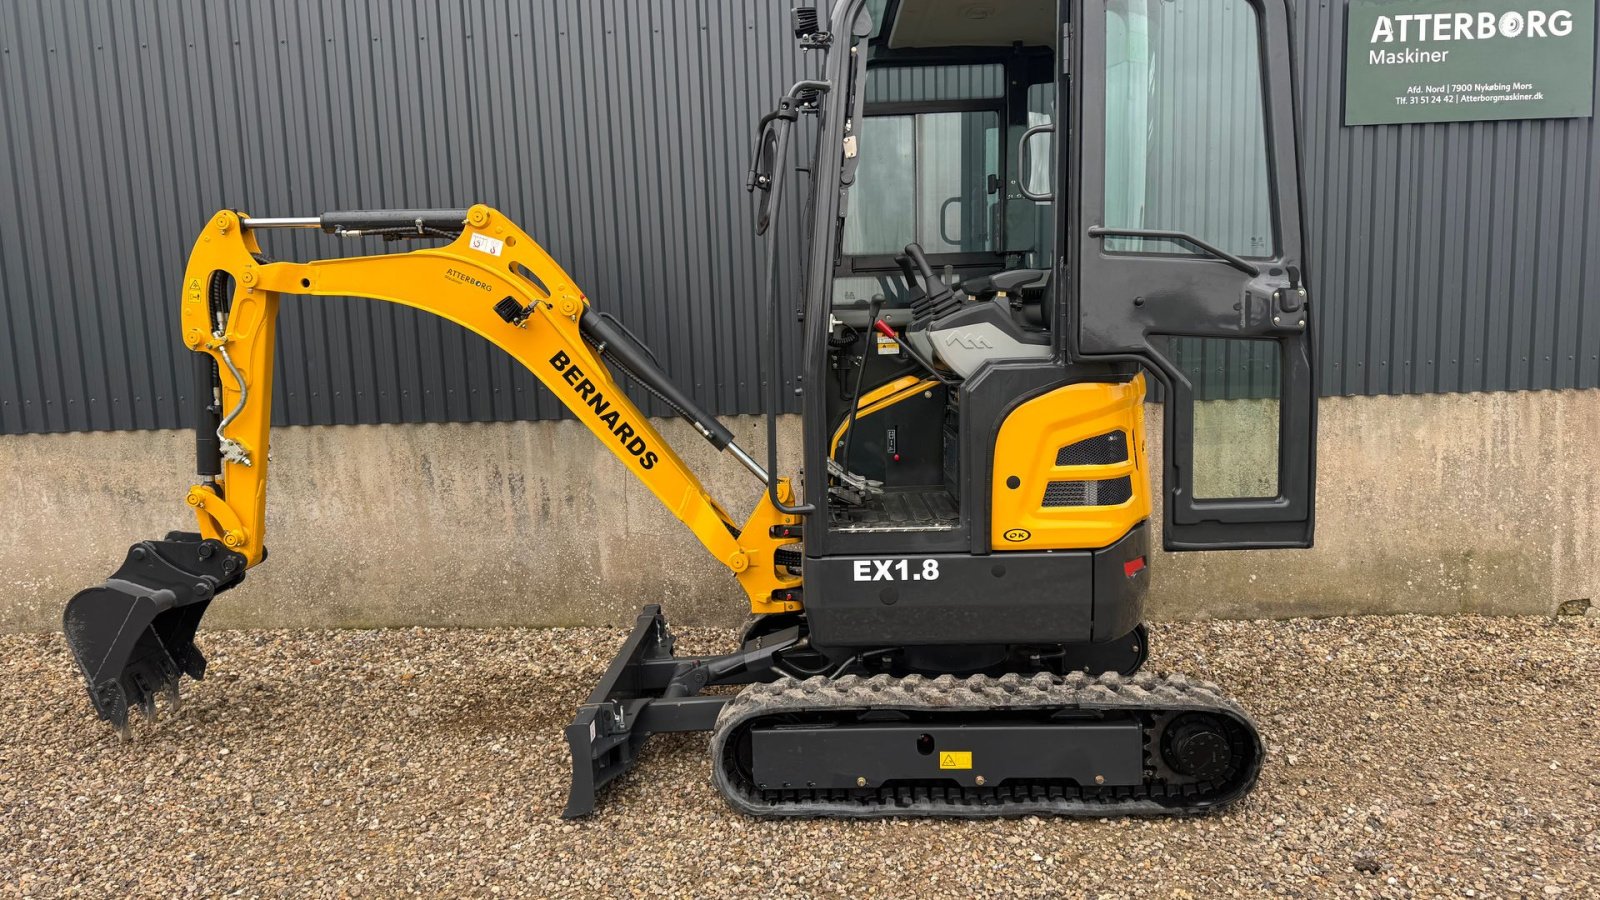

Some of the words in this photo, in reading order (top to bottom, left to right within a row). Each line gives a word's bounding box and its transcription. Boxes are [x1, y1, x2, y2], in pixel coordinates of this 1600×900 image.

[1370, 9, 1573, 43] ATTERBORG
[1369, 48, 1448, 65] Maskiner
[1407, 86, 1423, 94] Afd.
[1425, 85, 1445, 94] Nord
[1451, 84, 1473, 92] 7900
[1474, 83, 1511, 93] Nykøbing
[1512, 82, 1533, 91] Mors
[1395, 96, 1408, 105] Tlf.
[1409, 96, 1419, 105] 31
[1420, 96, 1429, 104] 51
[1430, 95, 1441, 104] 24
[1443, 95, 1454, 103] 42
[1460, 92, 1544, 104] Atterborgmaskiner.dk
[446, 268, 493, 292] ATTERBORG
[548, 349, 659, 470] BERNARDS
[1009, 532, 1026, 540] OK
[853, 559, 940, 582] EX1.8
